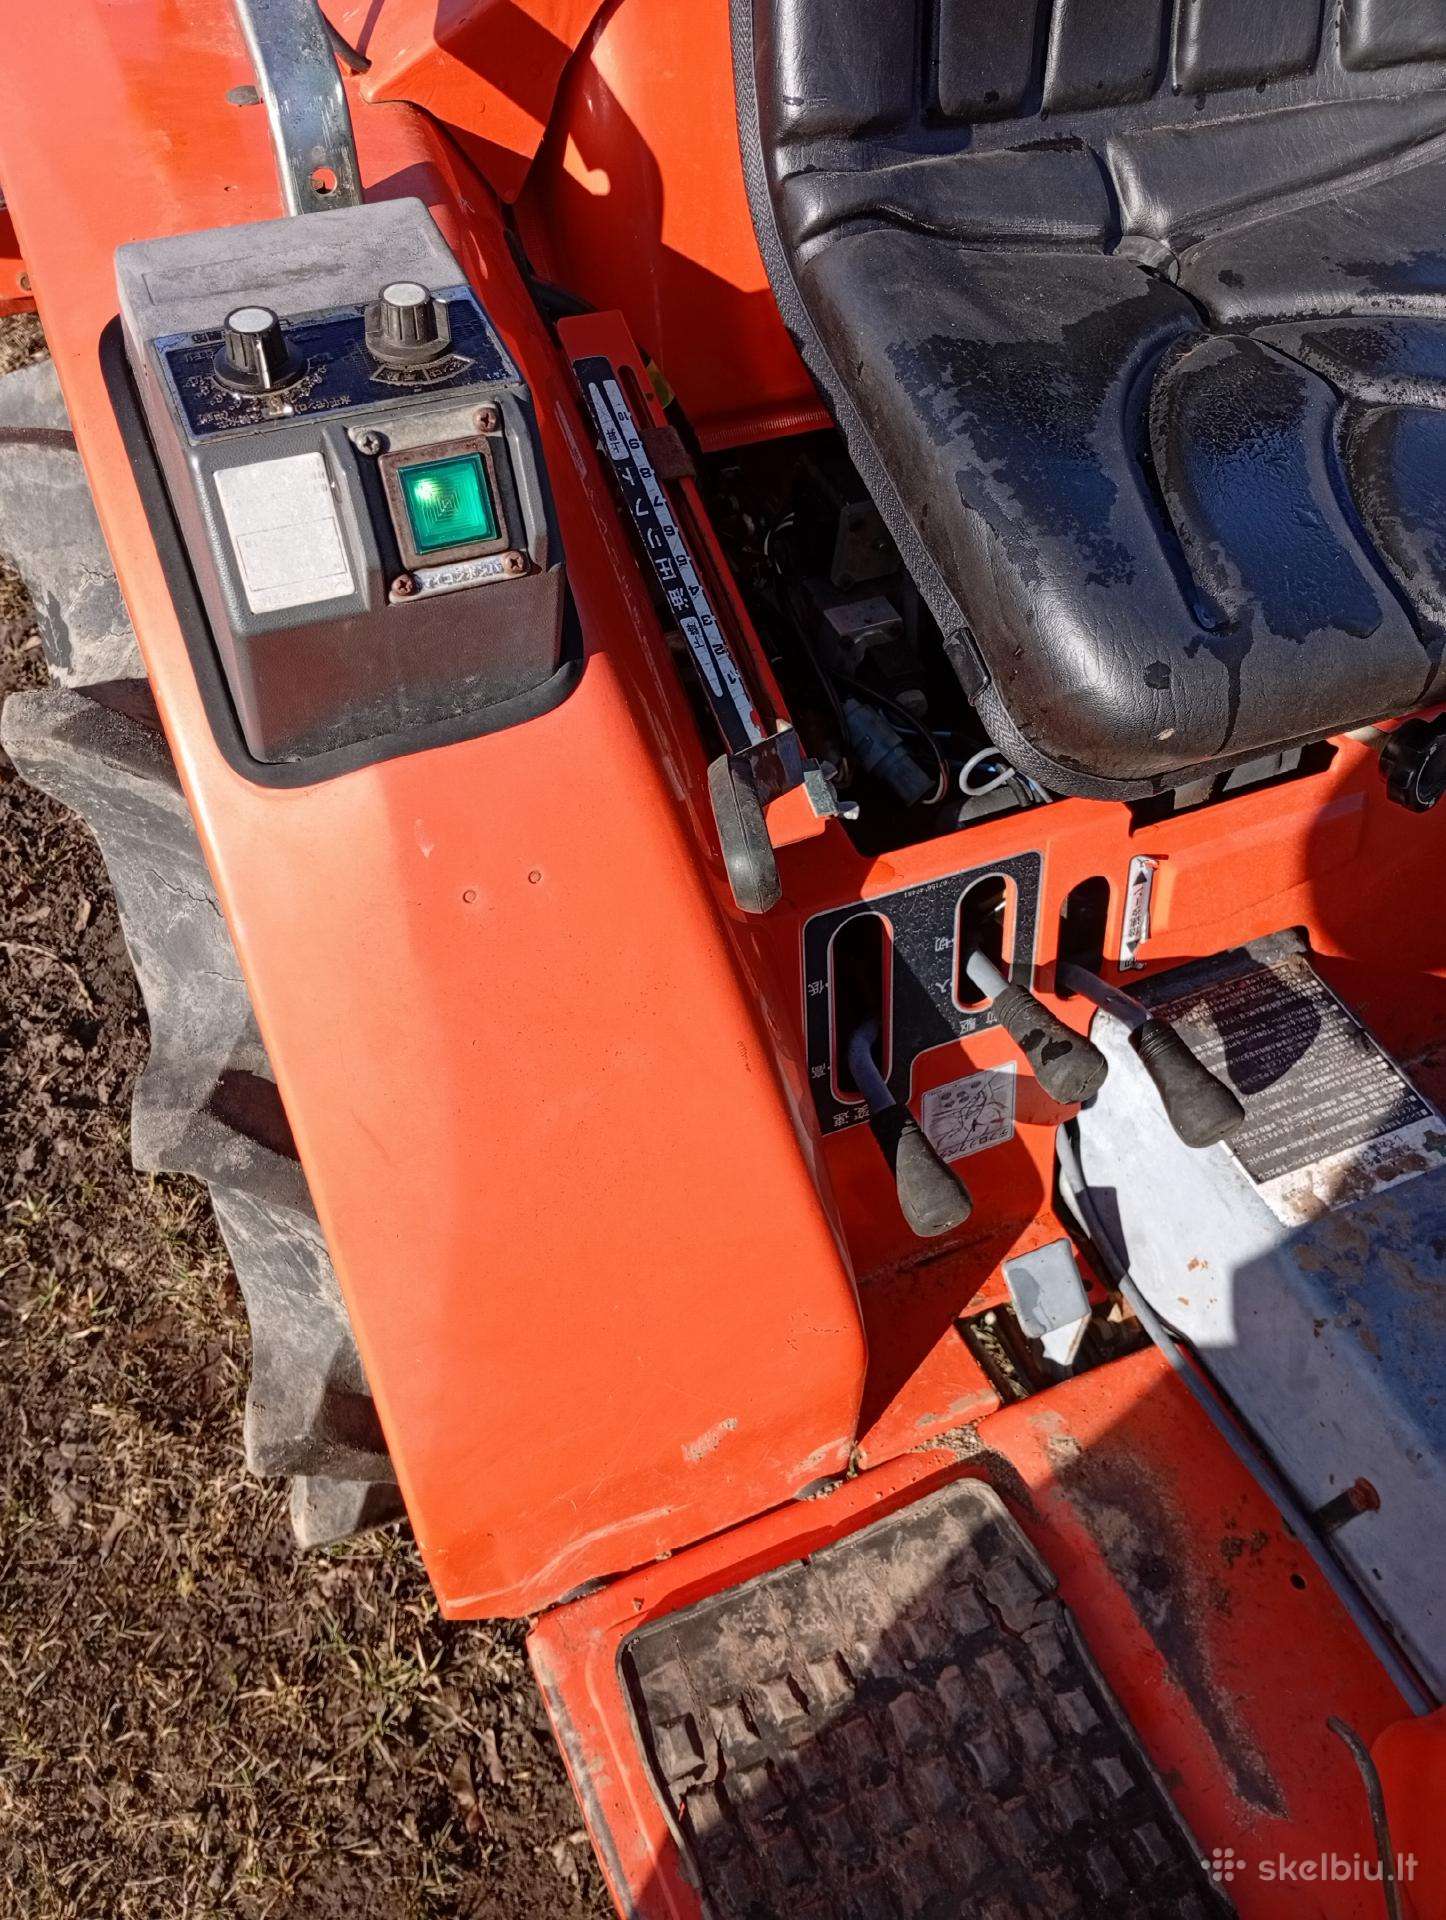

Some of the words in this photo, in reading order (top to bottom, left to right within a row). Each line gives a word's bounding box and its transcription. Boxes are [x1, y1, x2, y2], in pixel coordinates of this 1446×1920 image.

[617, 411, 630, 422] 10
[629, 438, 640, 449] 9
[640, 467, 652, 479] 8
[654, 496, 664, 507] 7
[664, 525, 676, 537] 6
[622, 466, 689, 611] 油圧リフト
[676, 554, 688, 567] 5
[688, 585, 700, 596] 4
[701, 614, 713, 626] 3
[712, 643, 725, 656] 2
[726, 669, 737, 685] 1
[807, 979, 824, 996] 低
[811, 1063, 826, 1078] 高
[832, 1104, 870, 1127] 変速
